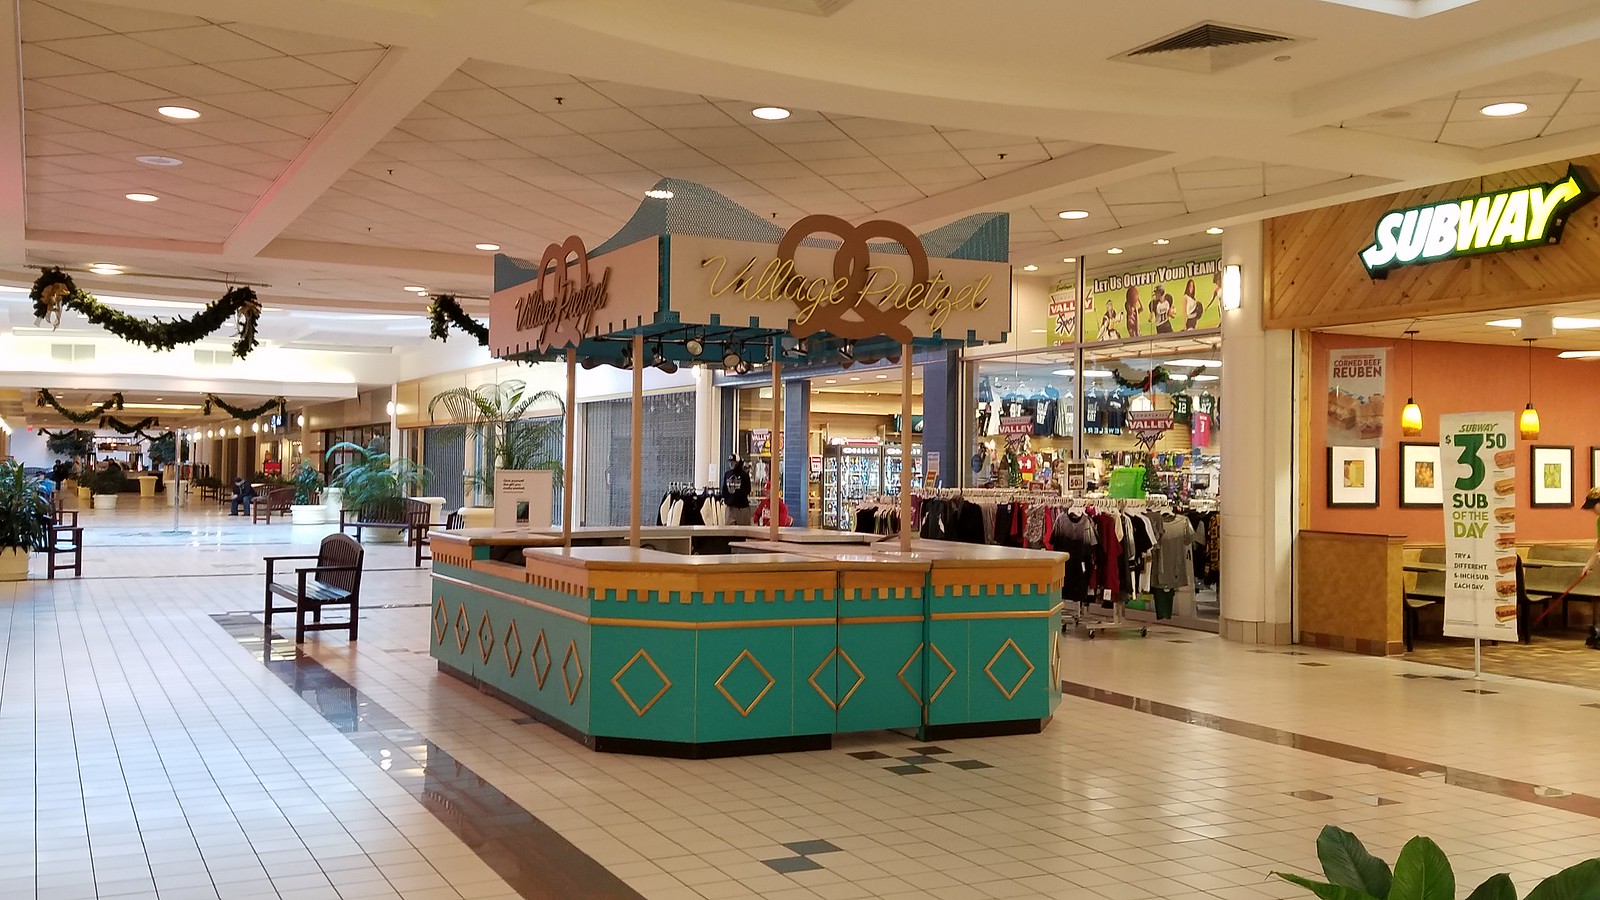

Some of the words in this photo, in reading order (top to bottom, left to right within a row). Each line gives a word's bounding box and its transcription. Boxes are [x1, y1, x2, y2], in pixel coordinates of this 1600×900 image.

[1362, 176, 1581, 270] SUBWAY
[1093, 278, 1109, 294] LET
[1109, 275, 1122, 291] US
[1123, 270, 1157, 289] OUTFIT
[1157, 264, 1186, 282] YOUR
[1186, 259, 1215, 278] TEAM
[702, 255, 848, 325] Village
[854, 266, 993, 332] Pretzel
[514, 287, 557, 344] Village
[560, 266, 611, 335] Pretzel
[1050, 300, 1092, 315] VALLY
[1333, 359, 1363, 367] CORNED
[1363, 358, 1382, 366] BEEF
[1333, 366, 1382, 379] REUBEN
[999, 424, 1033, 434] VALLEY
[1129, 419, 1174, 430] VALLEY
[1459, 423, 1499, 433] SUBWAY
[1134, 430, 1166, 451] Sports
[1452, 493, 1489, 508] SUB
[1452, 511, 1467, 520] OF
[1468, 511, 1489, 520] THE
[1453, 521, 1489, 538] DAY
[1453, 562, 1488, 570] DIFFERENT
